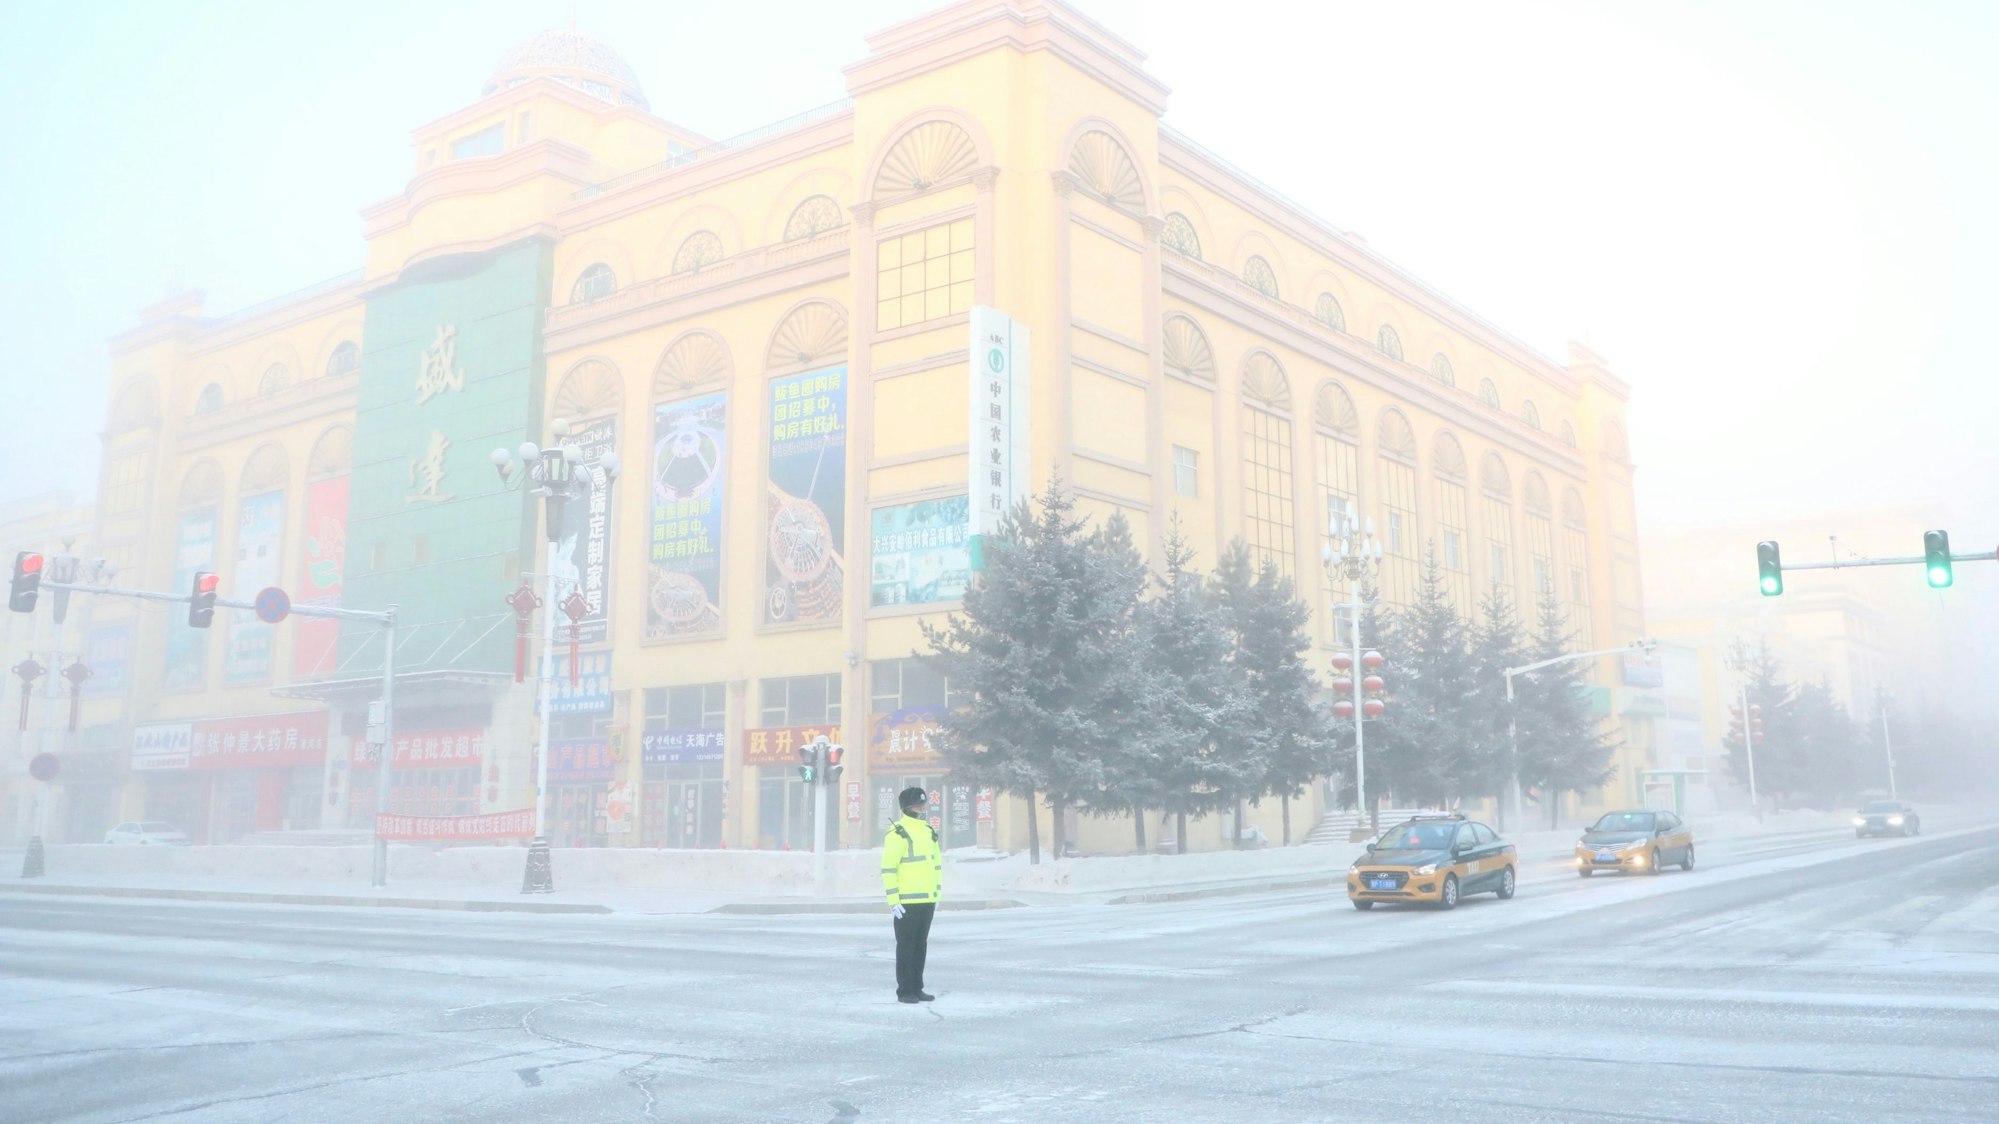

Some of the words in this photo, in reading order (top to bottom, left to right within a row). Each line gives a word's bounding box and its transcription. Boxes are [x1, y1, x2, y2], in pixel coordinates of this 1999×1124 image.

[989, 333, 1004, 346] ABC
[990, 380, 1002, 511] 中国农业银行
[586, 465, 607, 615] 高端定制家居
[207, 726, 299, 755] 张仲景大药房
[354, 735, 484, 762] 绿产品批发超市
[685, 731, 725, 748] 天海广告
[847, 783, 861, 818] 早餐
